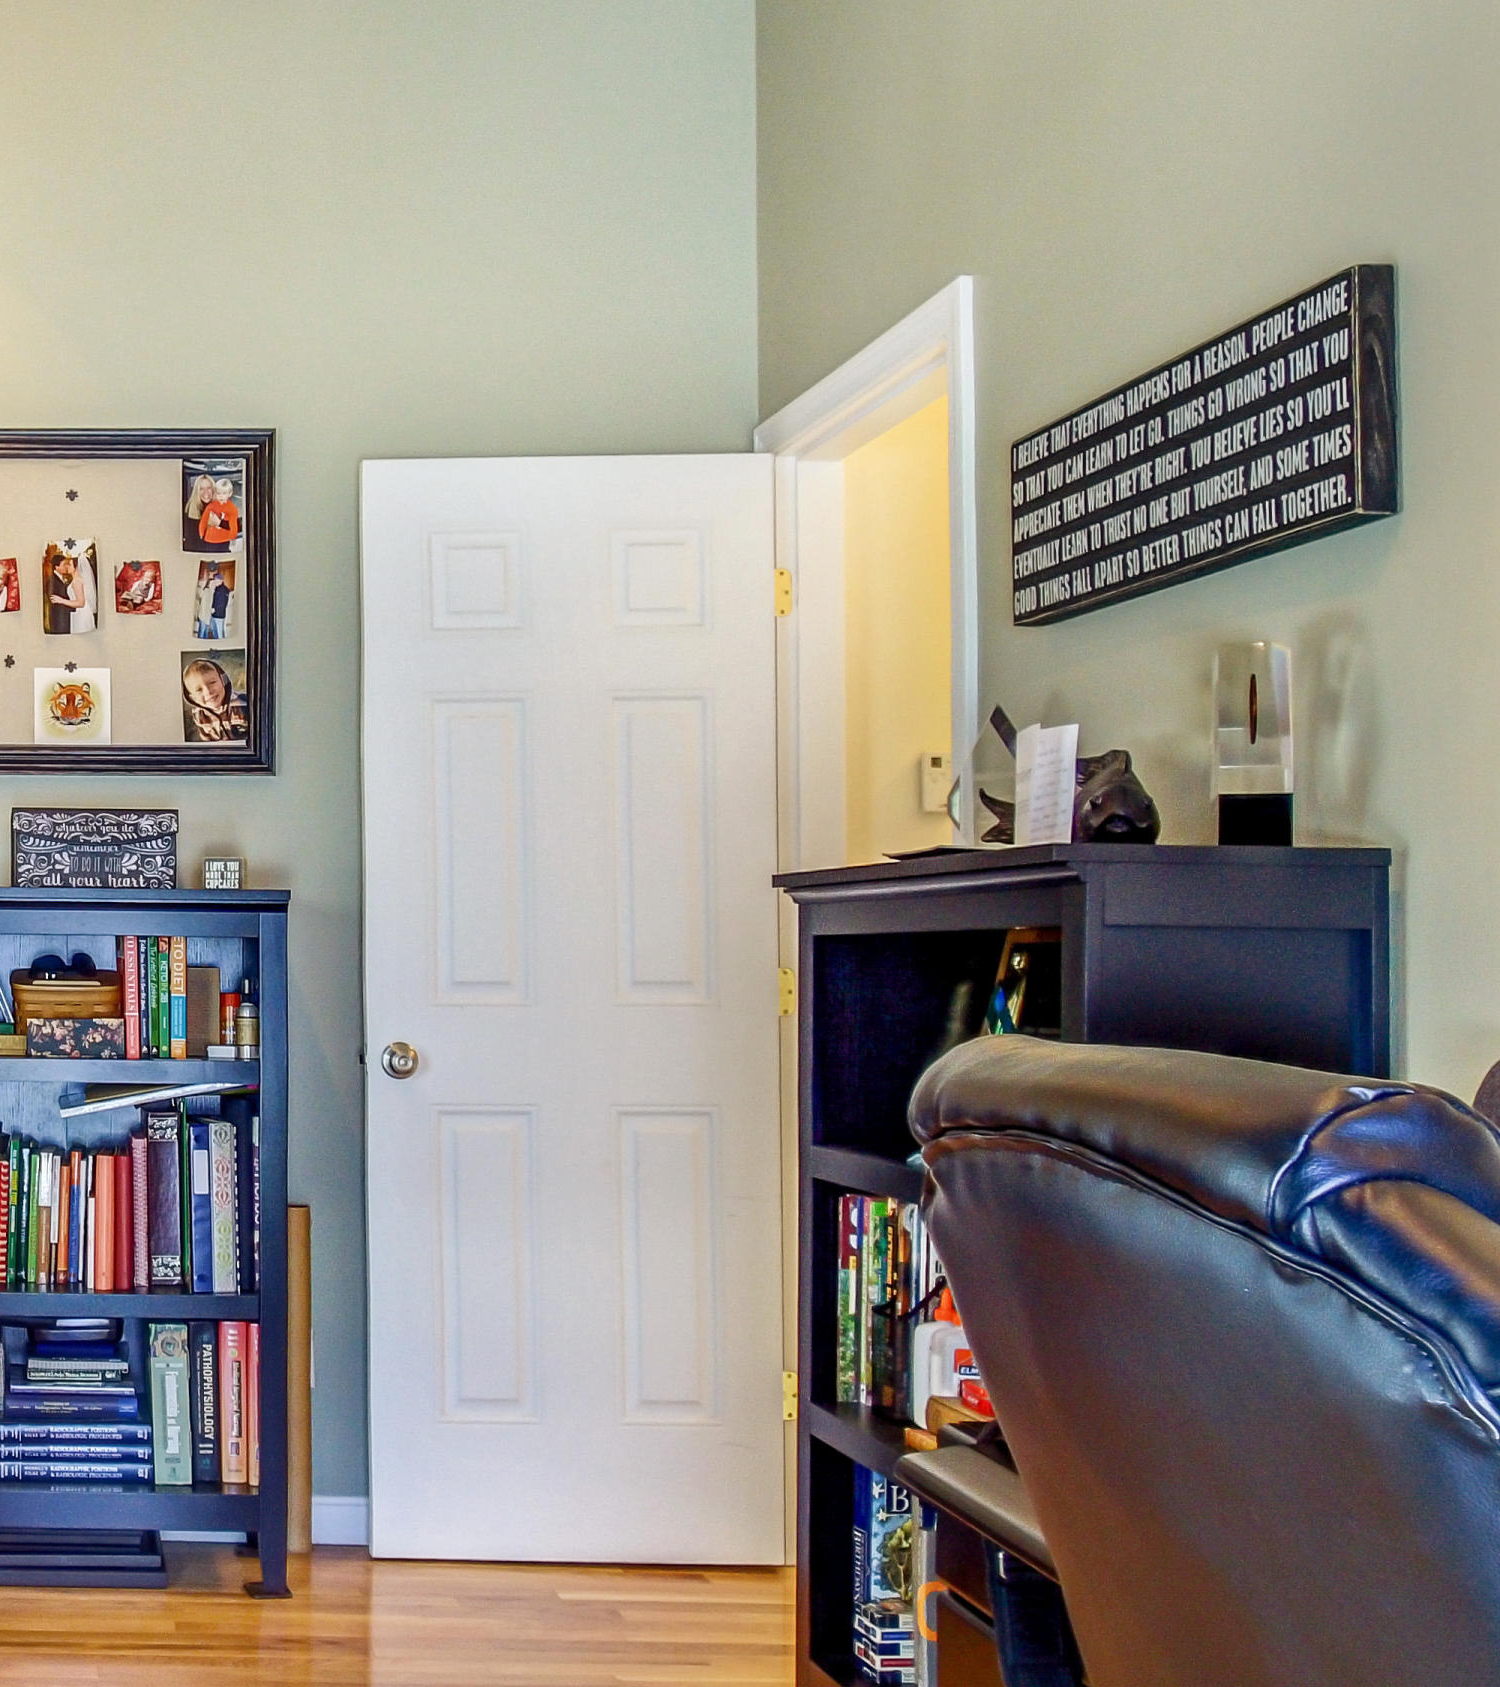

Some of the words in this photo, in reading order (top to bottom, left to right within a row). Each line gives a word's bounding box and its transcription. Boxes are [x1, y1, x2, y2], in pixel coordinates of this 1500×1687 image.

[1018, 438, 1049, 469] BELIEVE
[1051, 420, 1071, 453] THAT
[1072, 394, 1124, 443] EVERYTHING
[1126, 371, 1170, 417] HAPPENS
[1171, 358, 1191, 394] FOR
[1194, 355, 1201, 384] A
[1204, 332, 1250, 379] REASON.
[1252, 307, 1294, 355] PEOPLE
[1298, 280, 1348, 332] CHANGE
[1013, 481, 1024, 508] SO
[1025, 474, 1045, 502] THAT
[1047, 462, 1064, 493] YOU
[1065, 452, 1084, 484] CAN
[1085, 439, 1114, 476] LEARN
[1116, 436, 1128, 461] TO
[1129, 424, 1146, 456] LET
[1148, 416, 1164, 447] GO.
[1167, 396, 1205, 438] THINGS
[1208, 388, 1223, 420] GO
[1225, 367, 1267, 413] WRONG
[1270, 358, 1285, 392] SO
[1288, 342, 1319, 384] THAT
[1322, 328, 1349, 368] YOU
[1014, 500, 1061, 544] APPRECIATE
[1062, 490, 1085, 523] THEM
[1087, 478, 1113, 513] WHEN
[1115, 460, 1153, 502] THEY'RE
[1155, 446, 1188, 487] RIGHT.
[1190, 436, 1212, 470] YOU
[1214, 416, 1257, 461] BELIEVE
[1259, 404, 1285, 443] LIES
[1286, 396, 1304, 432] SO
[1306, 376, 1350, 423] YOU'LL
[1014, 539, 1060, 580] EVENTUALLY
[1062, 529, 1088, 563] LEARN
[1090, 522, 1101, 551] TO
[1103, 510, 1132, 546] TRUST
[1133, 504, 1147, 535] NO
[1150, 495, 1169, 529] ONE
[1171, 486, 1191, 521] BUT
[1193, 465, 1247, 512] YOURSELF,
[1249, 454, 1273, 492] AND
[1276, 440, 1310, 481] SOME
[1312, 424, 1351, 468] TIMES
[1014, 586, 1037, 616] GOOD
[1039, 573, 1071, 608] THINGS
[1072, 566, 1092, 597] FALL
[1094, 554, 1125, 590] APART
[1126, 548, 1140, 577] SO
[1142, 534, 1180, 573] BETTER
[1182, 512, 1222, 555] THINGS
[1225, 508, 1250, 544] CAN
[1252, 498, 1278, 535] FALL
[1281, 474, 1352, 525] TOGETHER.
[100, 825, 119, 834] you
[123, 823, 135, 833] do
[42, 872, 65, 887] all
[68, 876, 102, 888] your
[107, 874, 148, 888] heart
[70, 856, 79, 872] TO
[82, 856, 92, 872] DO
[94, 856, 101, 872] IT
[104, 856, 121, 873] WITH
[210, 861, 225, 871] LOVE
[227, 861, 240, 871] YOU
[205, 879, 240, 889] CUPCAKES
[126, 951, 137, 1012] ESSENTIALS
[160, 960, 168, 982] KETO
[160, 981, 168, 992] IN
[173, 962, 184, 993] DIET
[202, 1343, 215, 1440] PATHOPHYSIOLOGY
